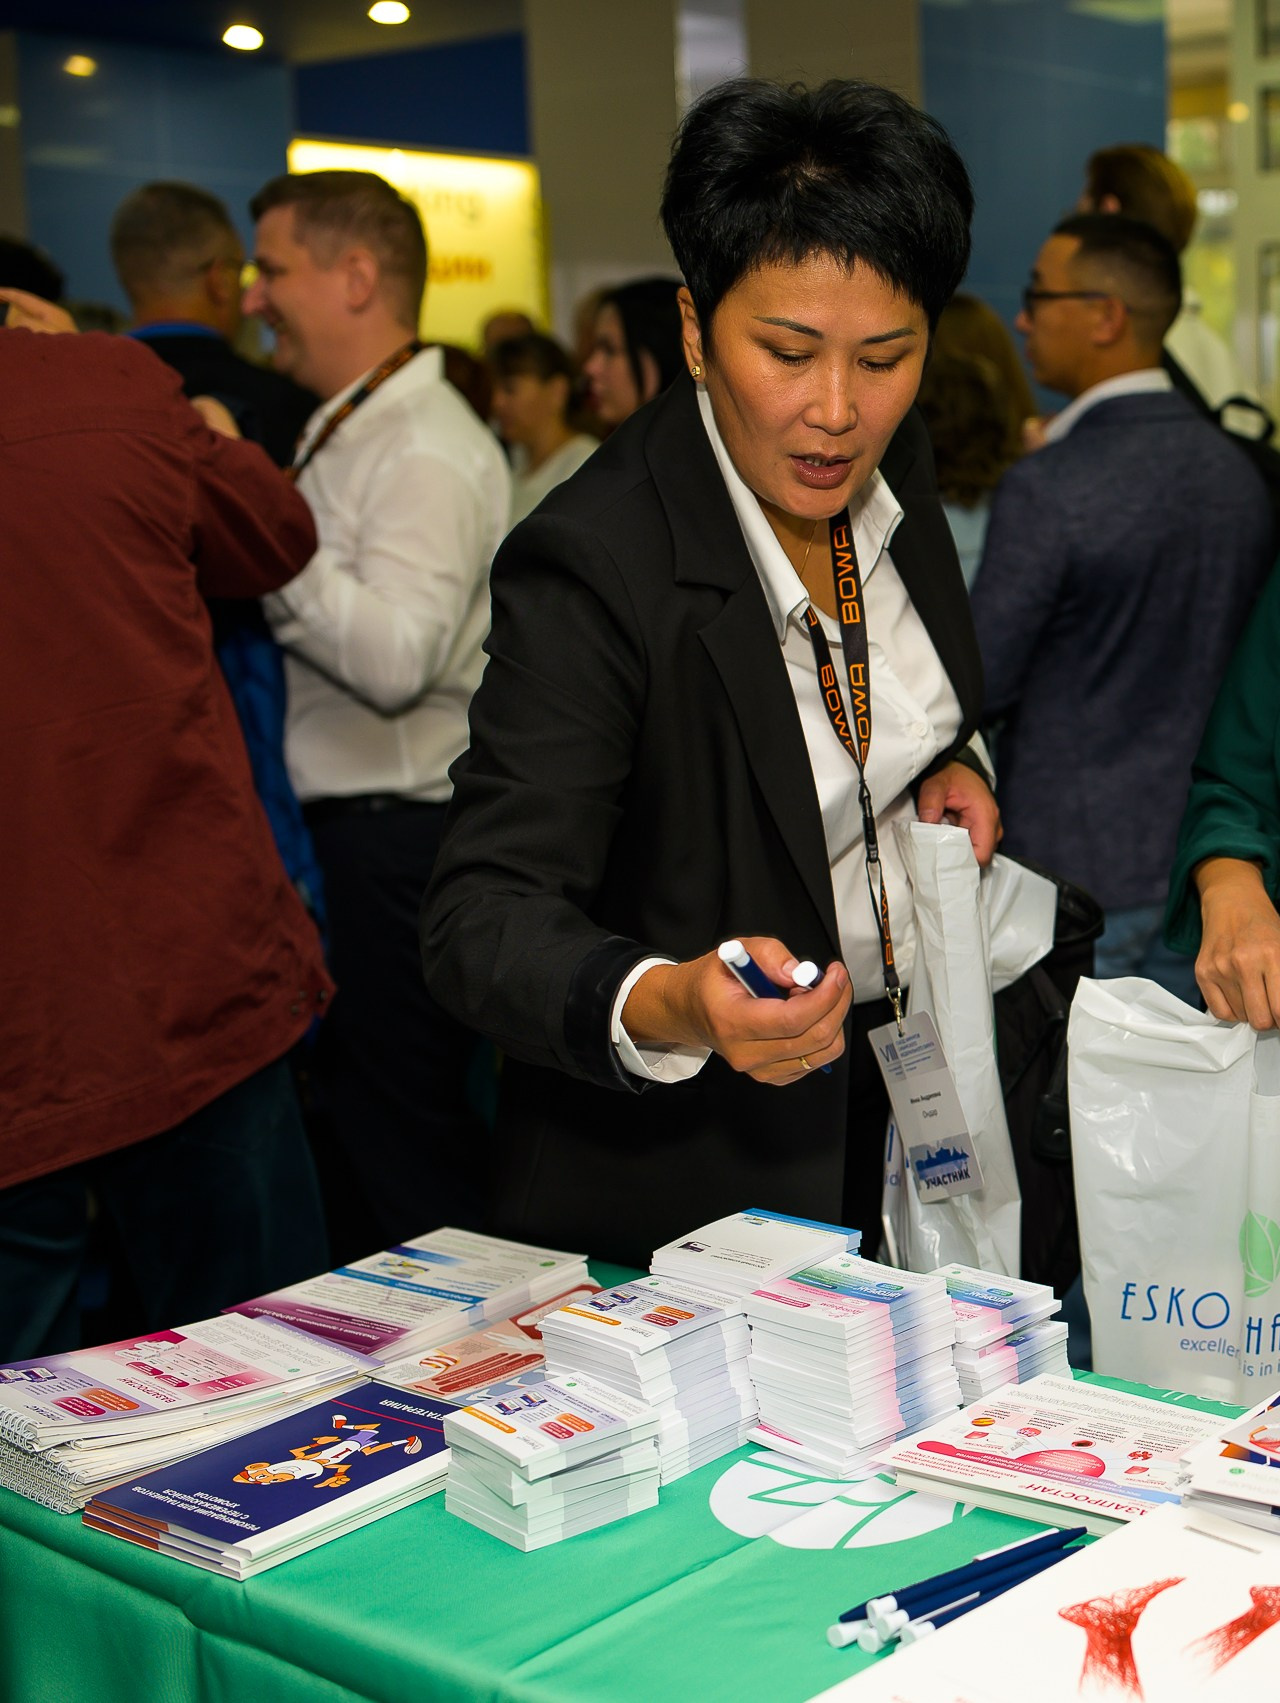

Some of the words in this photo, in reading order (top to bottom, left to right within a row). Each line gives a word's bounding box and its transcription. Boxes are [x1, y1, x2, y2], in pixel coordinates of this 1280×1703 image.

[832, 524, 860, 625] BOWA
[923, 1166, 971, 1189] УЧАСТНИК
[1121, 1283, 1230, 1329] ESKO
[1242, 1362, 1254, 1377] is
[1259, 1362, 1272, 1376] in
[131, 1486, 180, 1506] ПАЦИЕНТОВ
[162, 1488, 242, 1518] ПЕРЕМЕЖАЮЩЕЙСЯ
[180, 1502, 198, 1511] ДЛЯ
[194, 1491, 240, 1508] ХРОМОТОЙ
[194, 1508, 261, 1531] РЕКОМЕНДАЦИИ
